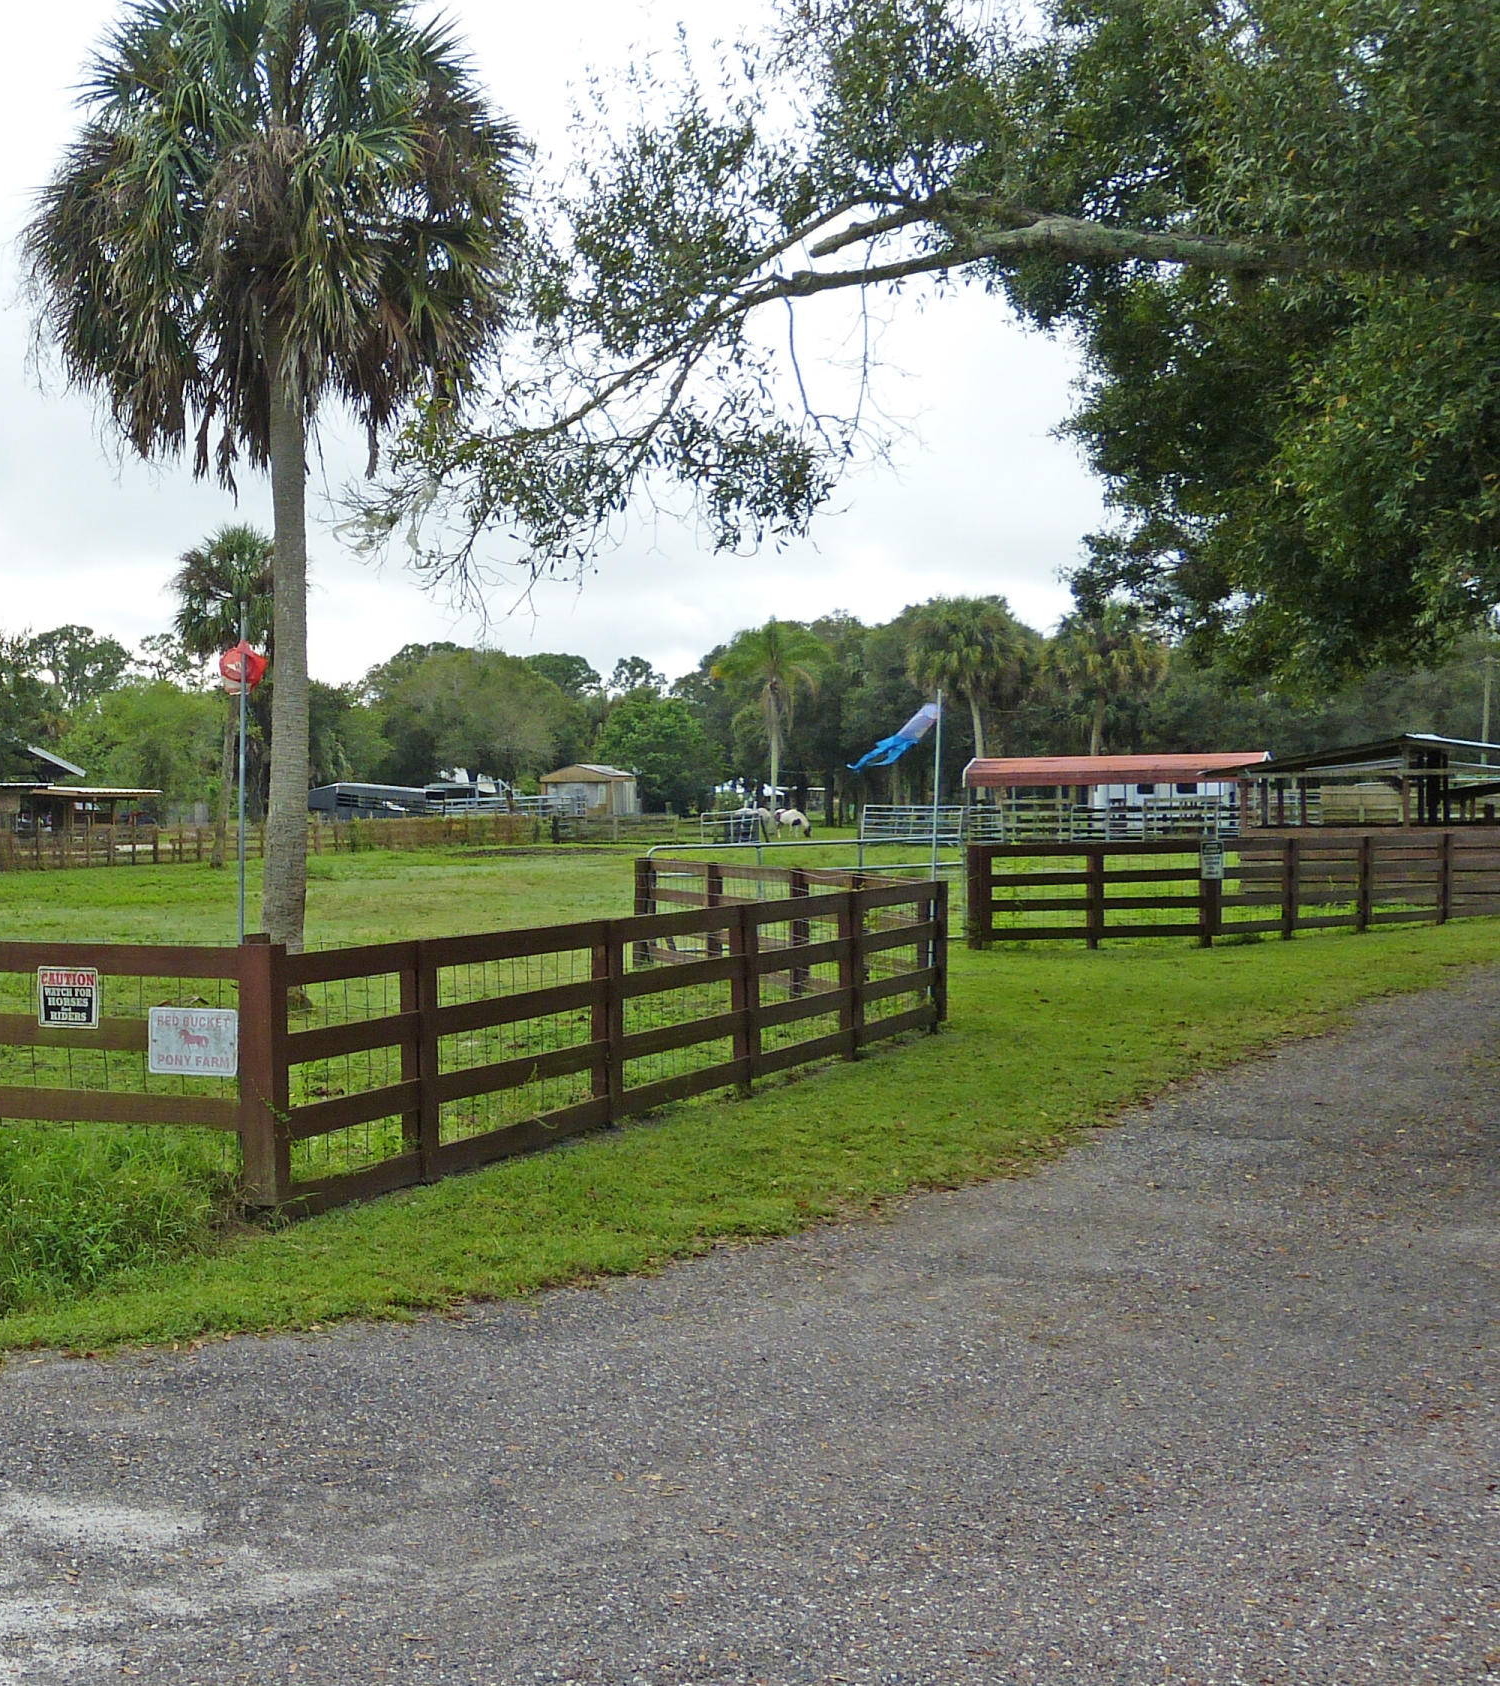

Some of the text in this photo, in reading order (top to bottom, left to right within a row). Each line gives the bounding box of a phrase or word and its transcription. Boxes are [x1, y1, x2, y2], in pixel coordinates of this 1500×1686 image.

[41, 972, 95, 986] CAUTION
[44, 987, 92, 998] WATCH FOR
[47, 997, 89, 1007] HORSES
[50, 1011, 87, 1022] RIDERS
[157, 1015, 231, 1029] RED BUCKET
[157, 1054, 230, 1068] PONY FARM
